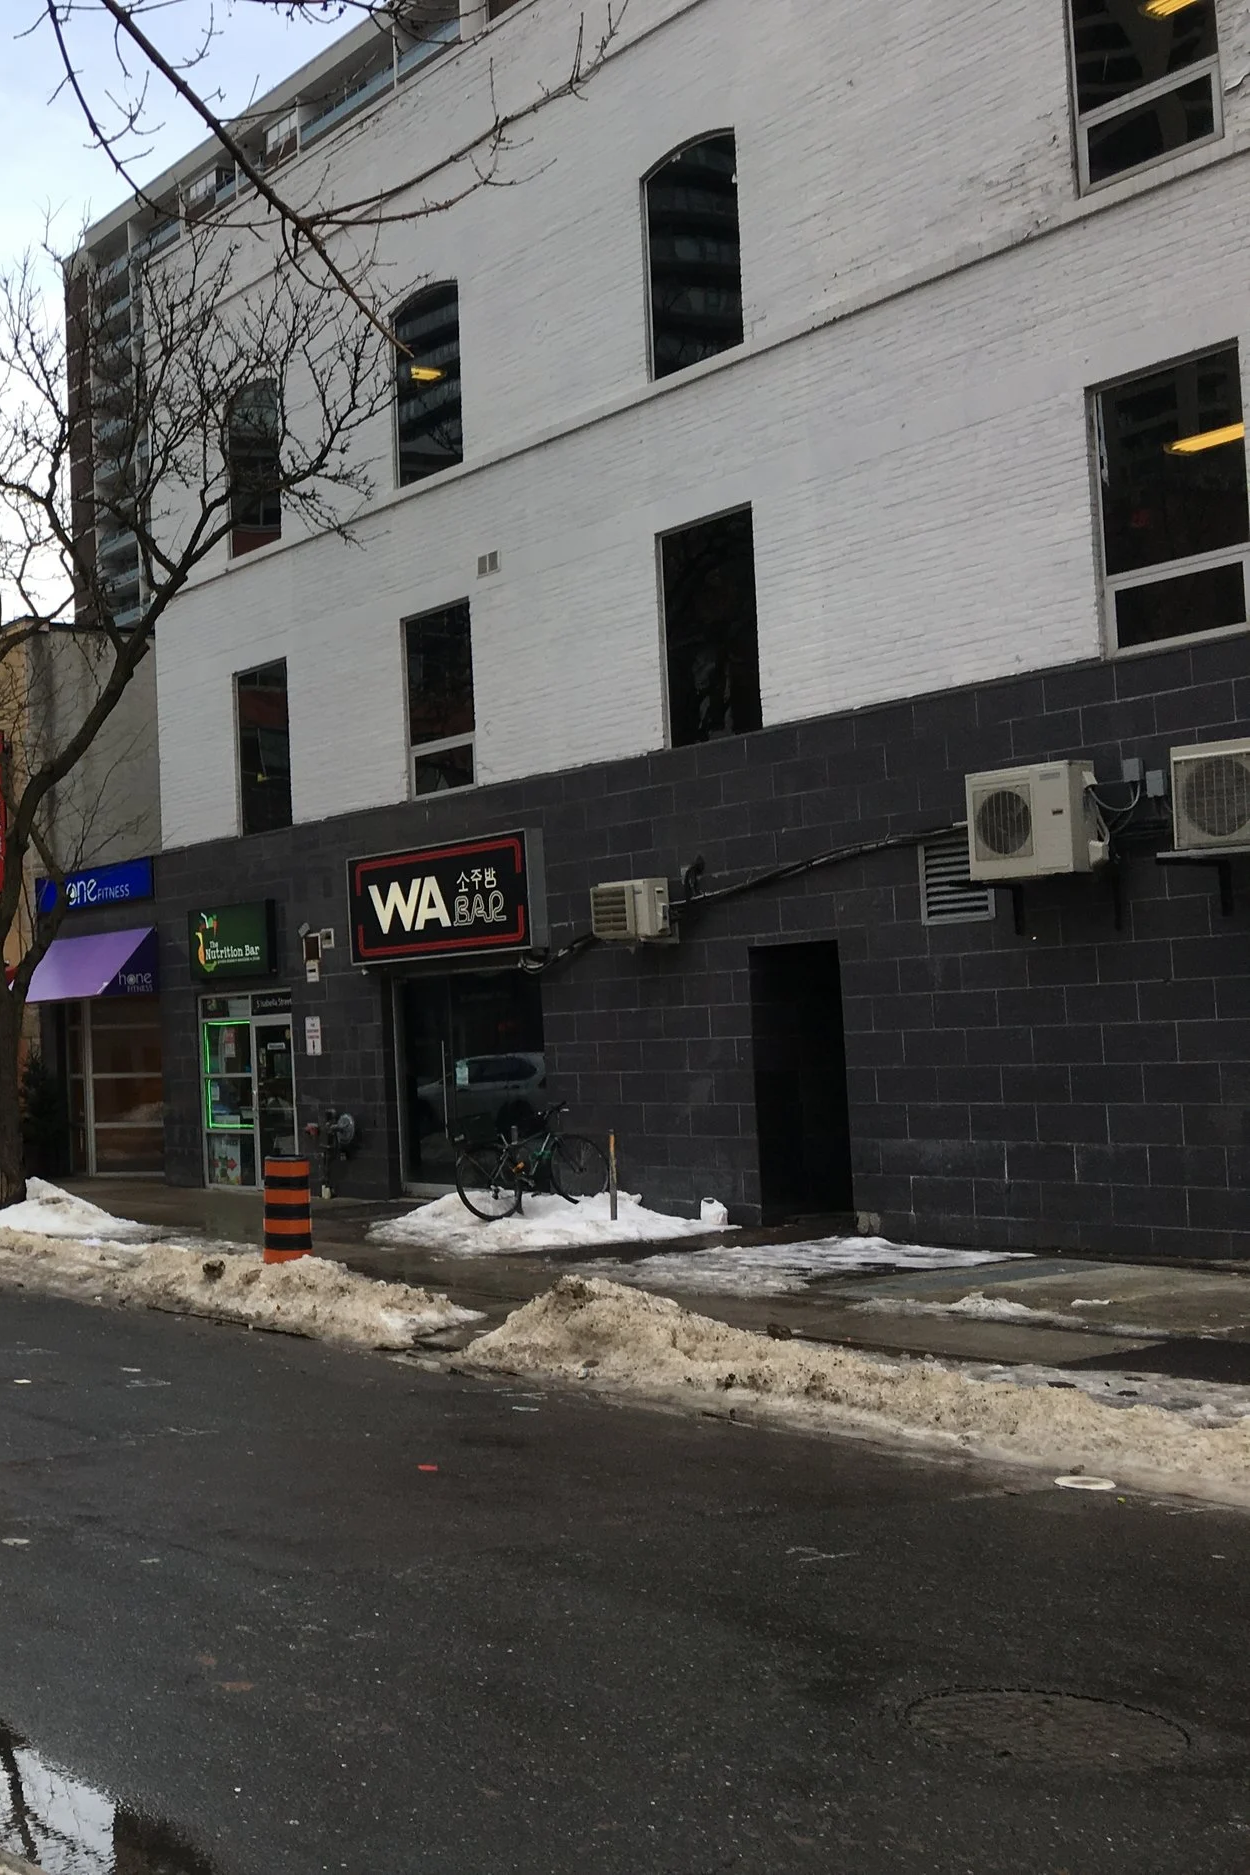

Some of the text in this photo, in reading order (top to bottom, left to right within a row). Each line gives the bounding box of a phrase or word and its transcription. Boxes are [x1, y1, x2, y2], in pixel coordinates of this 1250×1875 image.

[66, 878, 130, 906] one FITNESS
[368, 875, 452, 935] WA
[453, 889, 507, 927] BAR
[205, 945, 244, 961] Nutrition
[244, 944, 260, 956] Bar
[209, 940, 219, 948] The
[118, 971, 152, 985] hone
